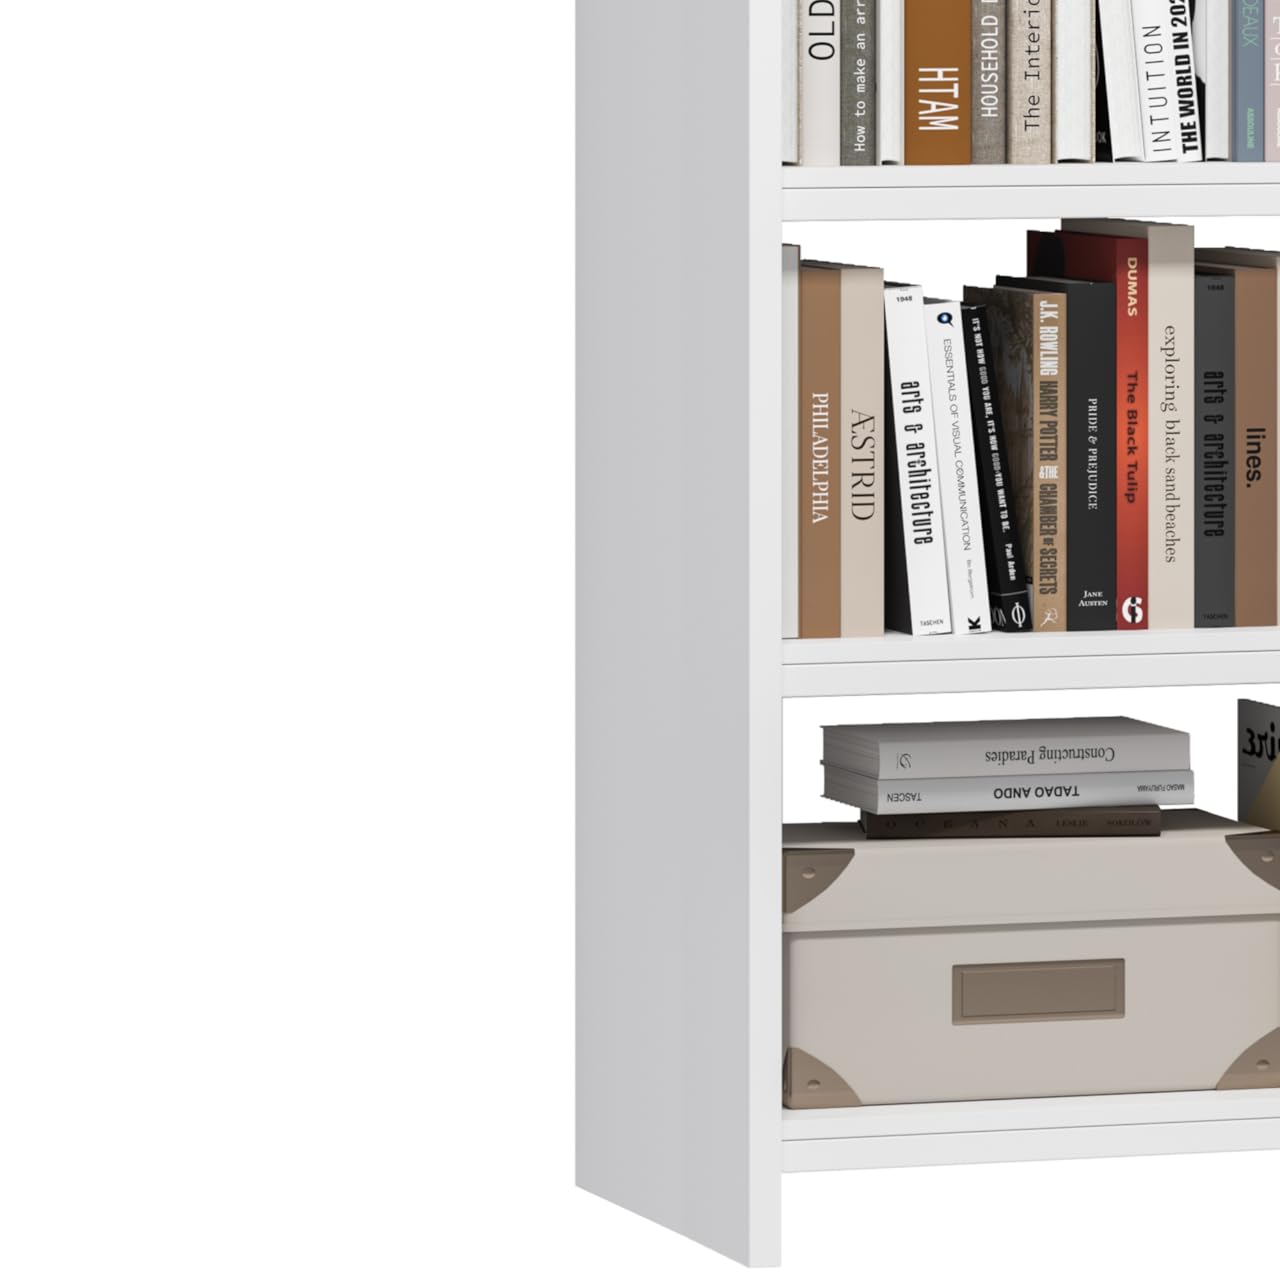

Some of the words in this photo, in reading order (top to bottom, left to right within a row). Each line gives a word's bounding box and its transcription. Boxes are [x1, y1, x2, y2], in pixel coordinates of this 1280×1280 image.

[808, 0, 835, 60] OLD
[1173, 32, 1189, 49] IN
[1142, 25, 1171, 152] INTUITION
[1175, 55, 1196, 118] WORLD
[1181, 121, 1198, 153] THE
[1128, 258, 1137, 316] DUMAS
[1040, 301, 1058, 322] J.K.
[944, 339, 957, 401] ESSENTIALS
[1040, 327, 1058, 375] ROWLING
[1160, 326, 1180, 412] exploring
[901, 380, 924, 414] arts
[1040, 381, 1058, 416] HARRY
[1127, 371, 1138, 403] The
[950, 403, 958, 418] OF
[1088, 399, 1097, 432] PRIDE
[952, 421, 962, 458] VISUAL
[1040, 421, 1058, 461] POTTER
[1127, 410, 1138, 455] Black
[1165, 420, 1180, 462] black
[813, 393, 828, 523] PHILADELPHIA
[852, 410, 875, 520] ÆSTRID
[1087, 449, 1097, 509] PREJUDICE
[1246, 428, 1266, 488] lines.
[906, 443, 933, 544] architecture
[1124, 461, 1138, 503] Tulip
[1165, 468, 1180, 500] sand
[955, 460, 972, 550] COMMUNICATION
[1040, 484, 1057, 536] CHAMBER
[1165, 504, 1180, 563] beaches
[1039, 548, 1057, 594] SECRETS
[1079, 598, 1108, 606] AUSTEN
[1084, 591, 1102, 599] JANE
[985, 750, 1035, 765] Paradies
[1039, 746, 1115, 763] Constructing
[887, 793, 921, 802] TASCEN
[994, 787, 1031, 799] ANDO
[1035, 786, 1079, 798] TADAO
